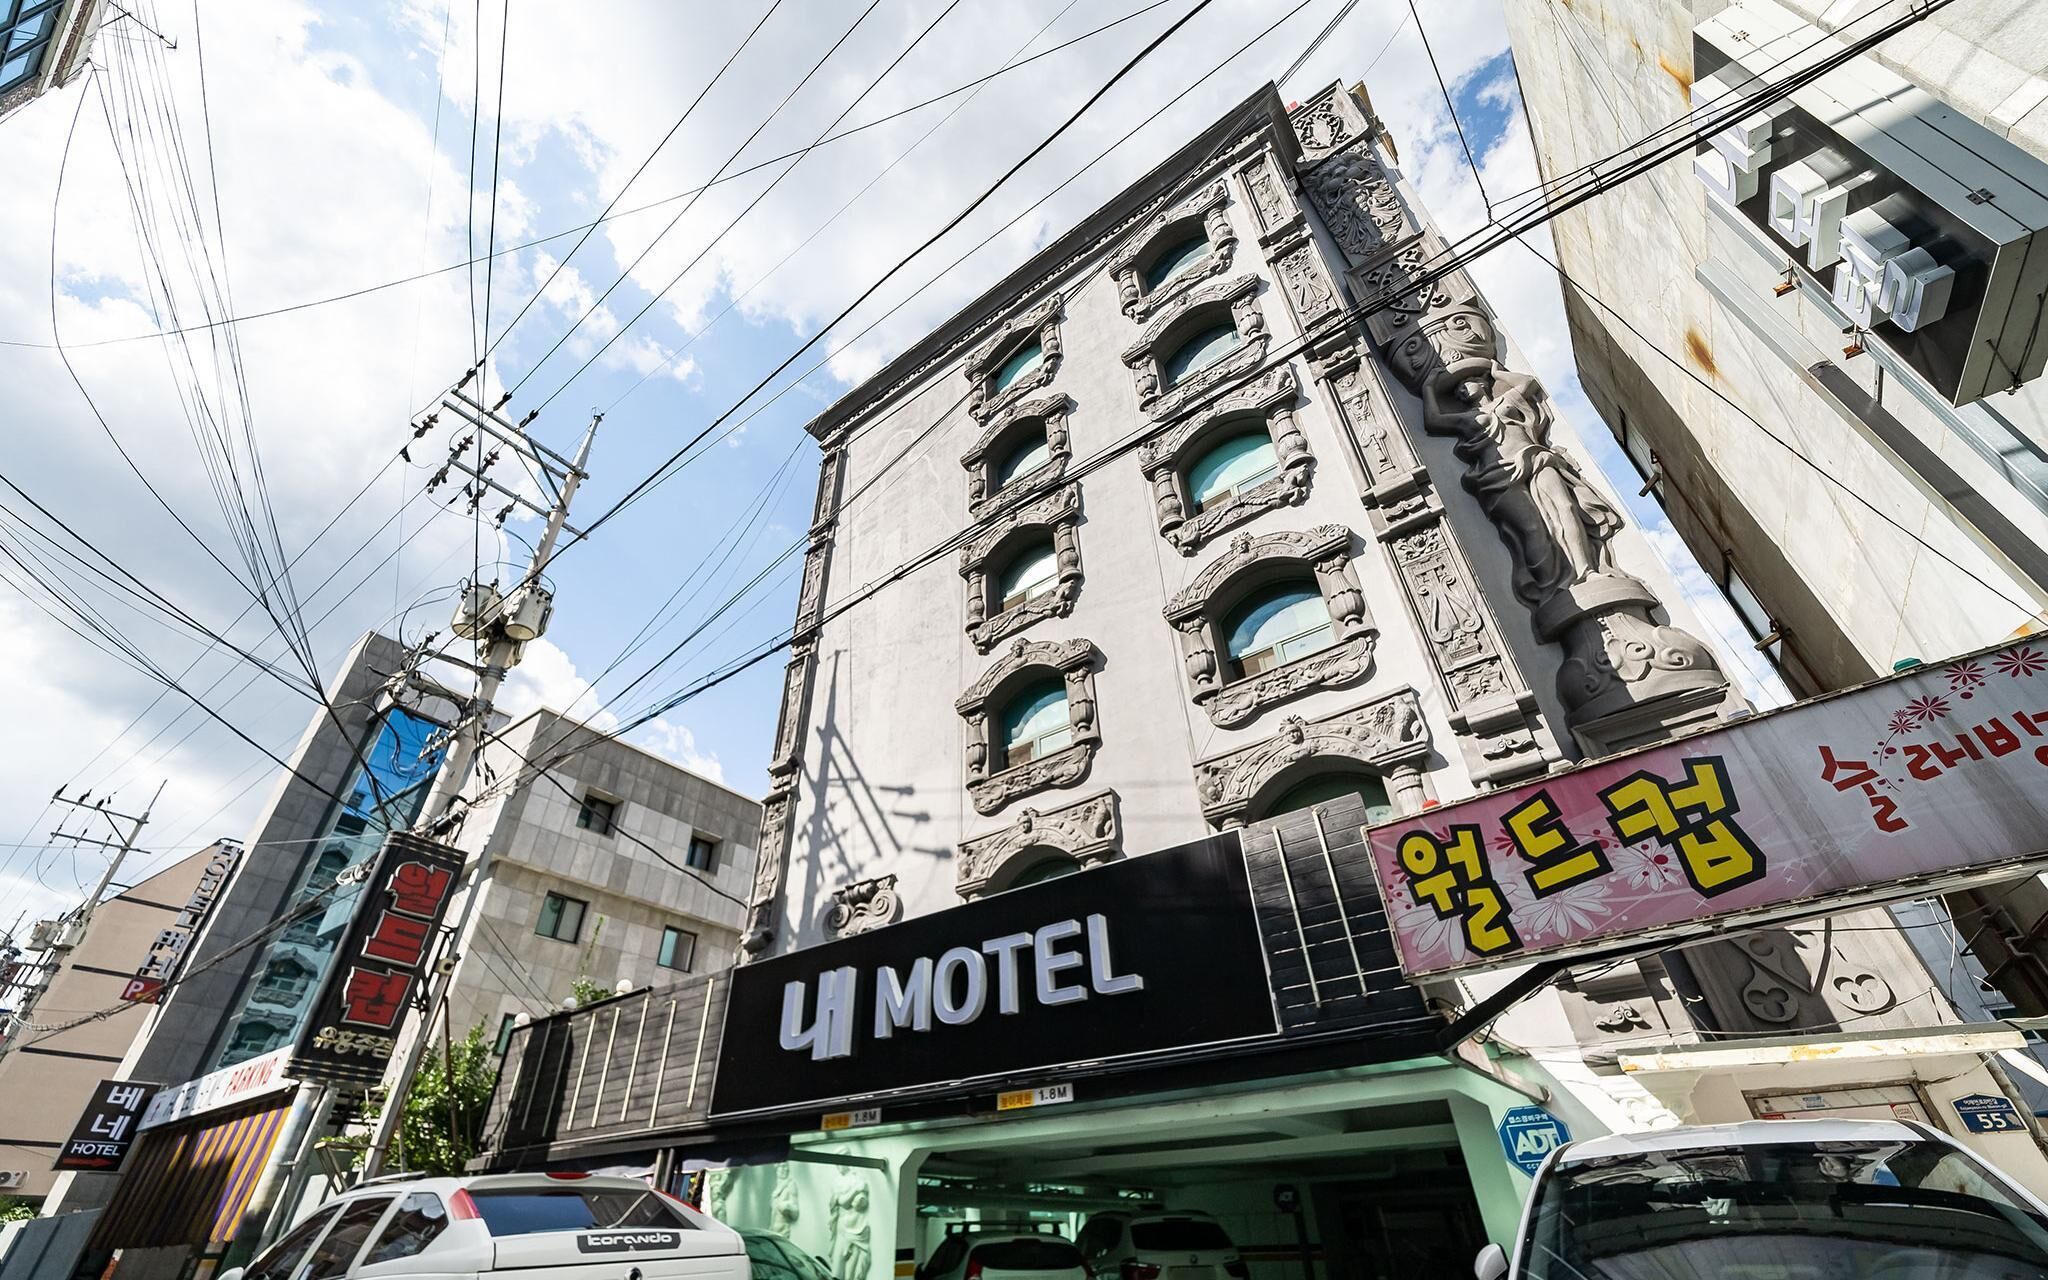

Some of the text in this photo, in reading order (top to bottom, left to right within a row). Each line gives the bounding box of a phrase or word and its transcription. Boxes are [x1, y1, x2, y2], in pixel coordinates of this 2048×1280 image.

[1396, 756, 1767, 958] 월드컵
[175, 844, 240, 928] HOTEL
[342, 860, 454, 1030] 월드컵
[126, 981, 145, 997] P
[873, 913, 1145, 1040] MOTEL
[313, 1025, 397, 1059] 유흥주점
[223, 1056, 279, 1098] PARKING
[1038, 1086, 1067, 1101] 1.8M
[90, 1085, 146, 1141] 베네
[1976, 1112, 2007, 1129] 55
[70, 1143, 121, 1156] HOTEL
[1516, 1128, 1556, 1155] ADT
[586, 1231, 673, 1246] korando
